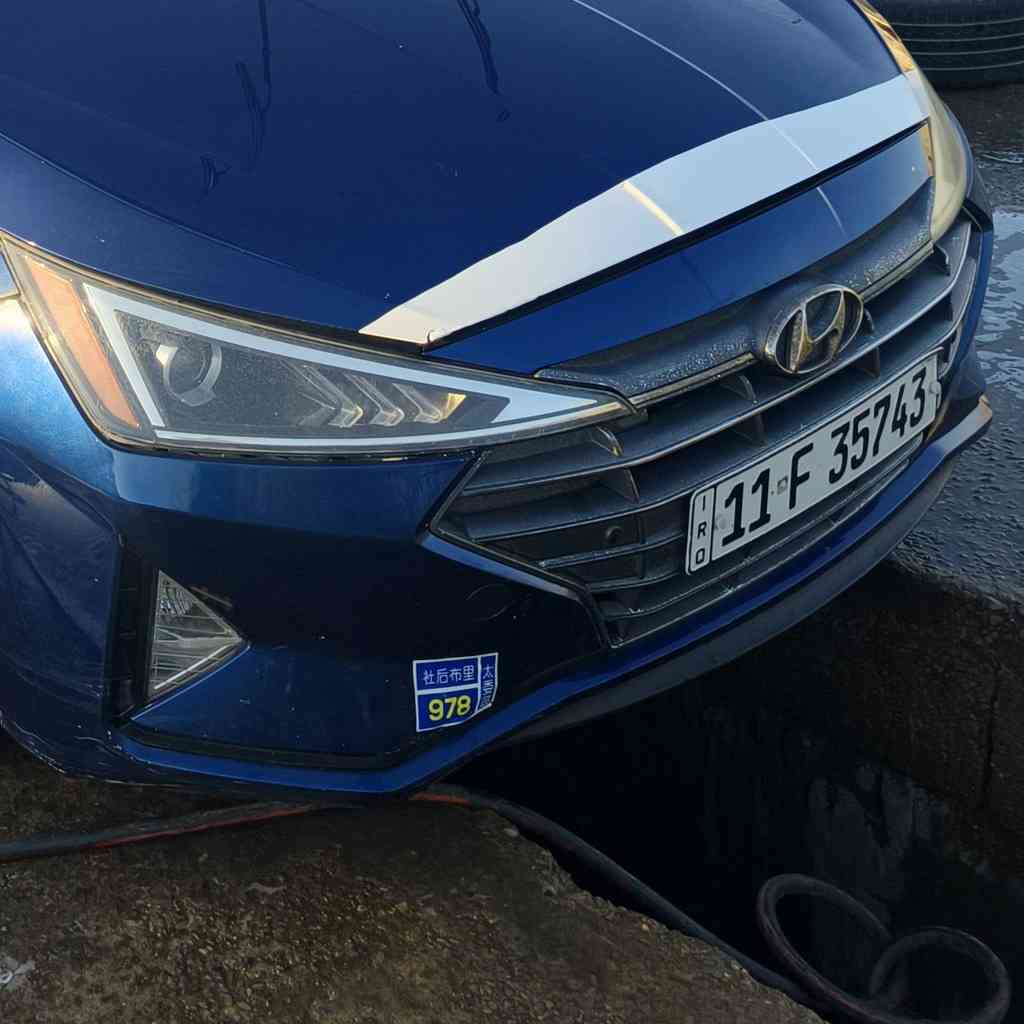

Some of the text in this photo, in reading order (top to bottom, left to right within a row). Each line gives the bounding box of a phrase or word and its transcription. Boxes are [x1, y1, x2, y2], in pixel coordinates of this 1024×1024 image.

[722, 367, 926, 546] 11 F 35743
[429, 695, 471, 721] 978
